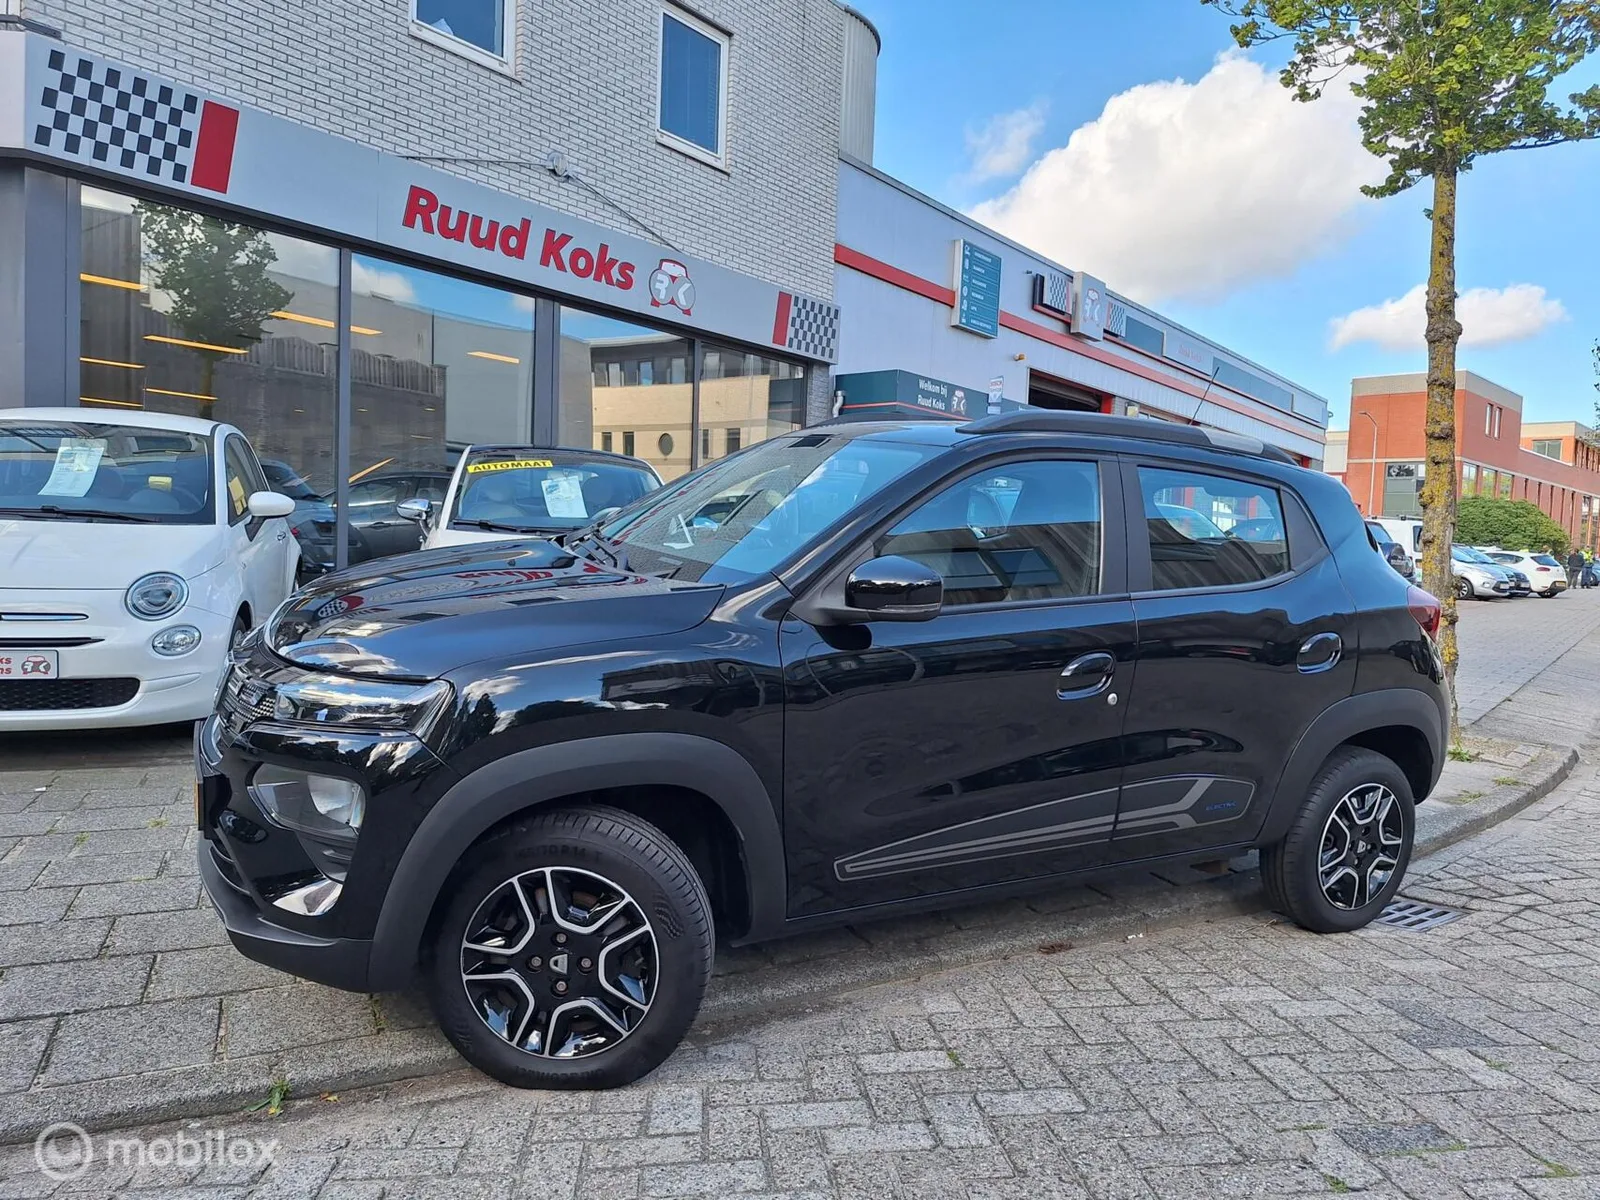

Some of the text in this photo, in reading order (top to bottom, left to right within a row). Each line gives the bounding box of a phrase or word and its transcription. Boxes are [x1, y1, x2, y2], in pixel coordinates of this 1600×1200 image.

[402, 185, 635, 290] Ruud Koks
[918, 378, 940, 393] Welkom
[917, 395, 945, 411] Ruud Koks
[473, 461, 547, 471] AUTOMAAT
